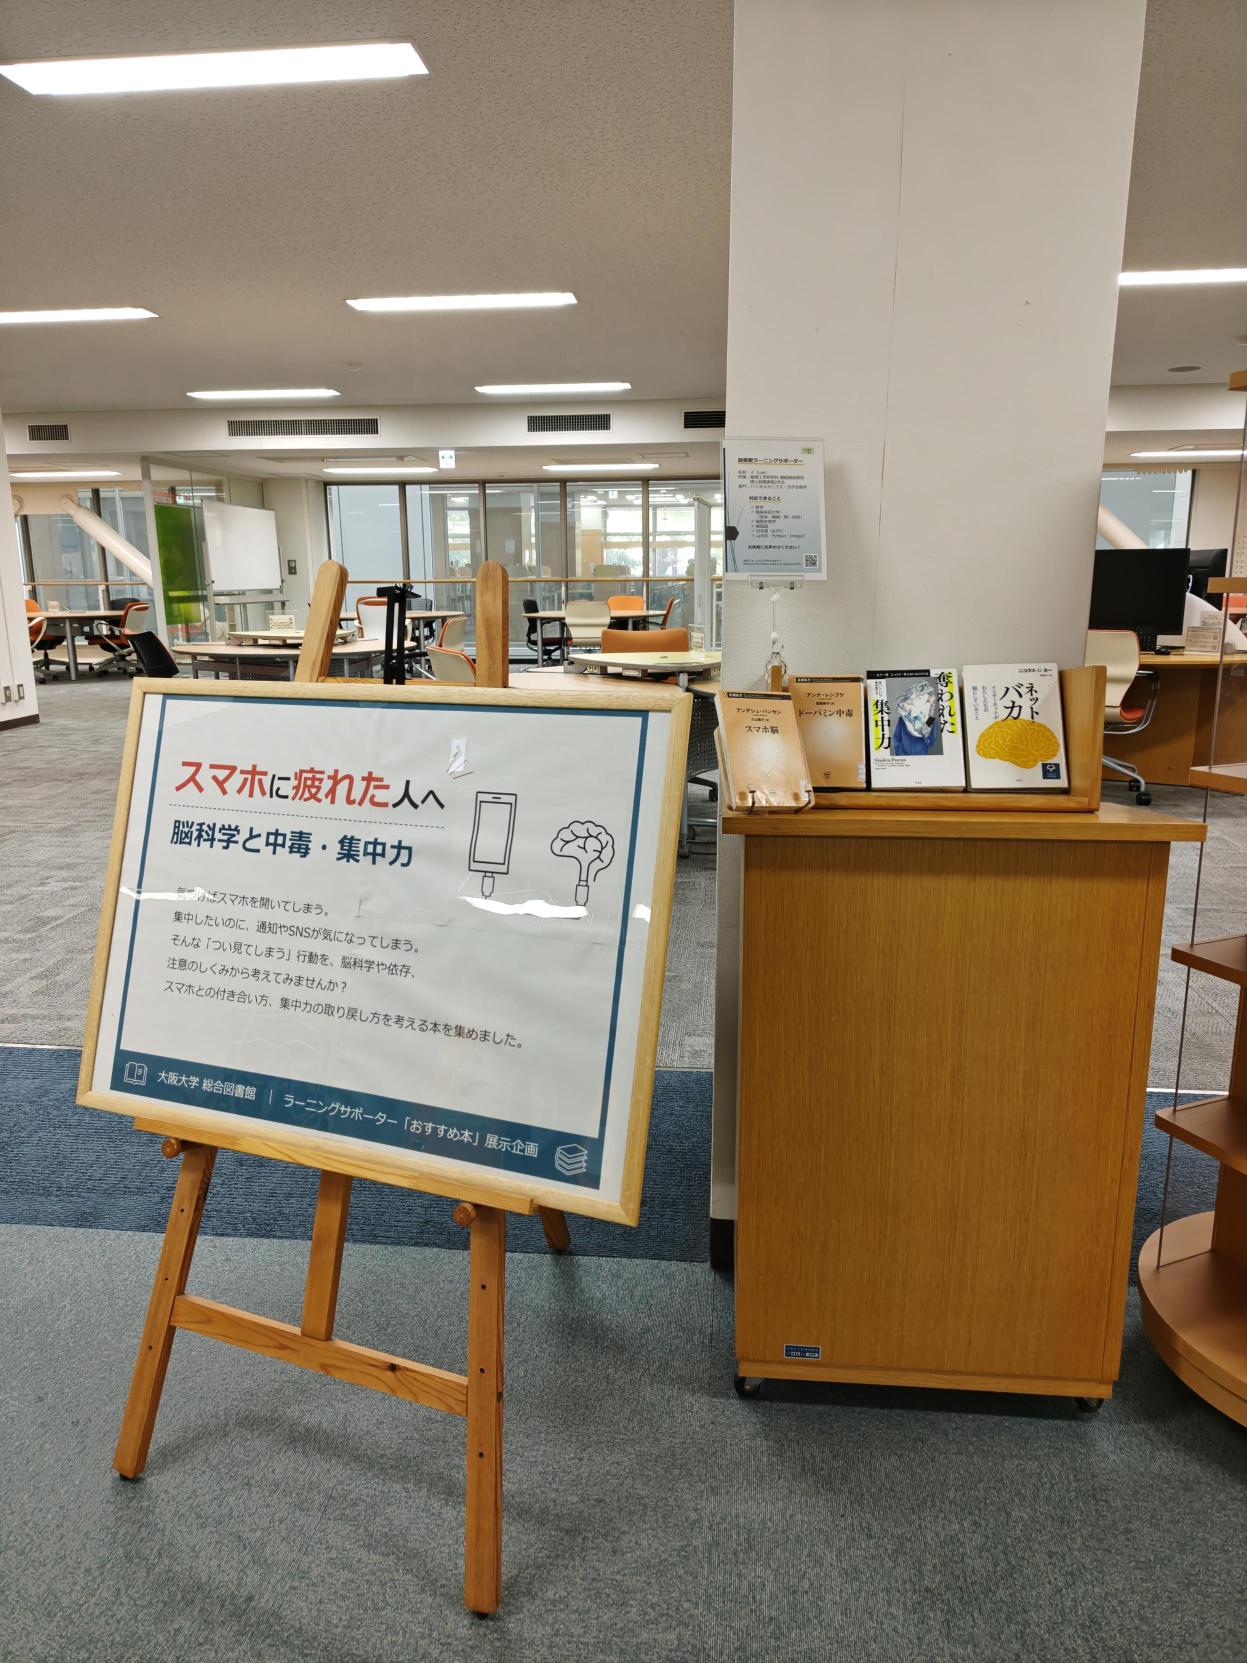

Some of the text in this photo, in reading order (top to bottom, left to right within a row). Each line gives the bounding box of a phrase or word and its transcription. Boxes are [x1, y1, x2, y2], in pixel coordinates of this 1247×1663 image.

[798, 708, 854, 718] ドーパミン中毒
[936, 671, 957, 734] 奪われた
[999, 682, 1024, 722] バカ
[745, 725, 779, 735] スマホ脳
[872, 699, 891, 751] 集中力
[174, 760, 446, 810] スマホに疲れた人へ
[169, 819, 414, 868] 脳科学と中毒・集中力
[166, 957, 348, 993] 注意のしくみから考えてみませんか？
[156, 1069, 200, 1090] 大阪大学
[201, 1077, 258, 1101] 総合図書館
